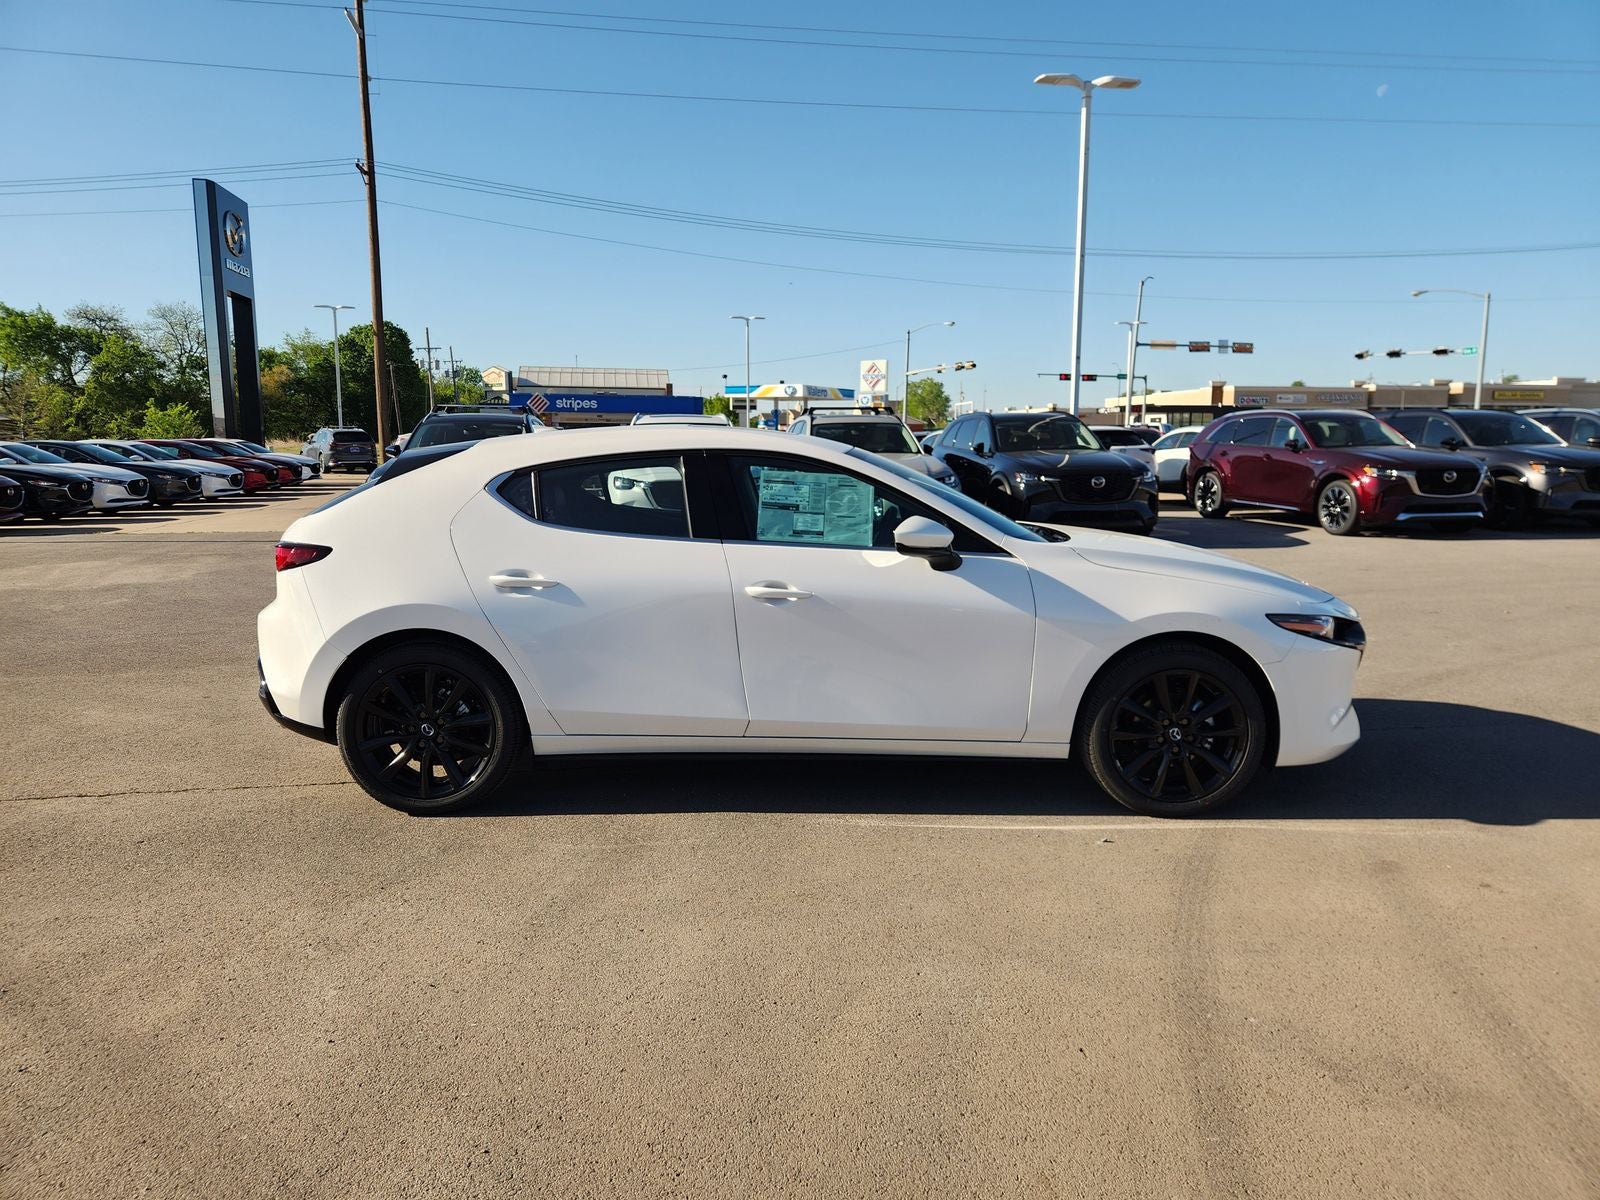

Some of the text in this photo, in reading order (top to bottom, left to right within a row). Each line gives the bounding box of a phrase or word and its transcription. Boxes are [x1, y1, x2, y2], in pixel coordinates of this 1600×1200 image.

[226, 259, 251, 278] mazda
[806, 385, 827, 397] Valero
[556, 397, 598, 411] stripes
